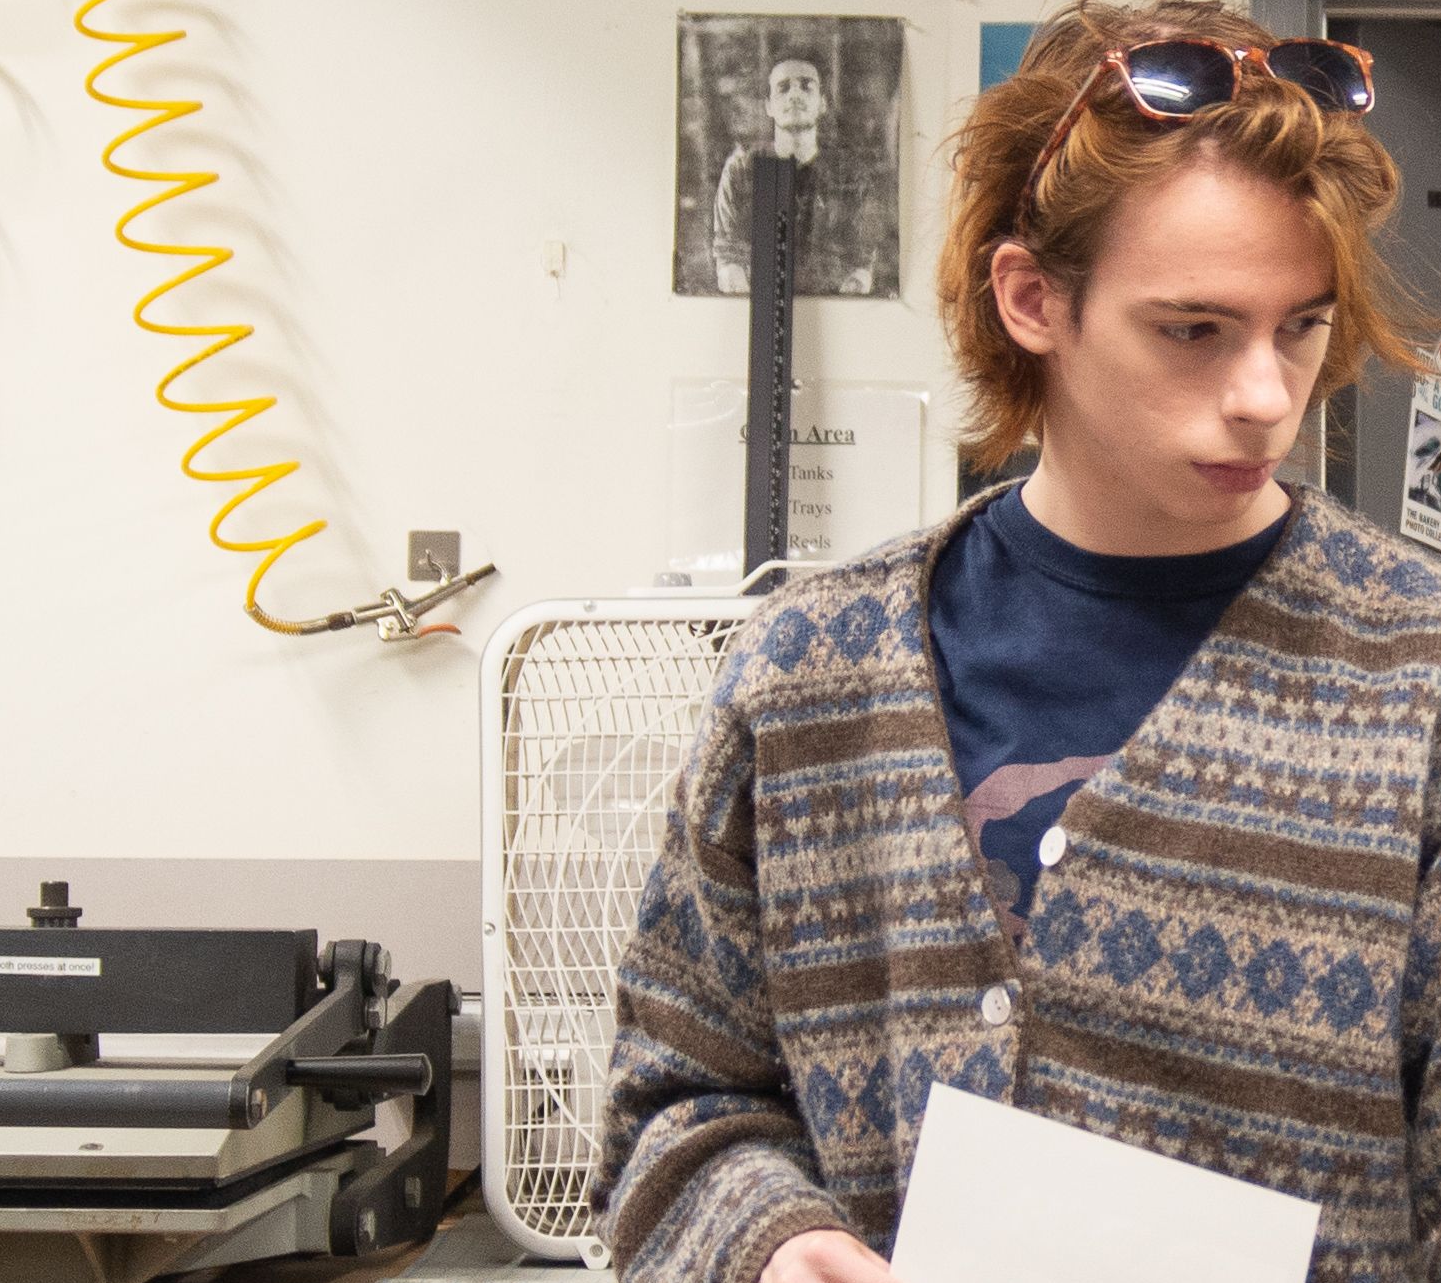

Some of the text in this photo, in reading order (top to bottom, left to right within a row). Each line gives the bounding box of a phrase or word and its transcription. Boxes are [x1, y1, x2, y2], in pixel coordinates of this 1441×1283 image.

[805, 424, 856, 444] Area
[790, 465, 834, 481] Tanks
[789, 499, 833, 518] Trays
[789, 534, 832, 550] Reels
[17, 963, 56, 974] presses
[57, 963, 67, 972] at
